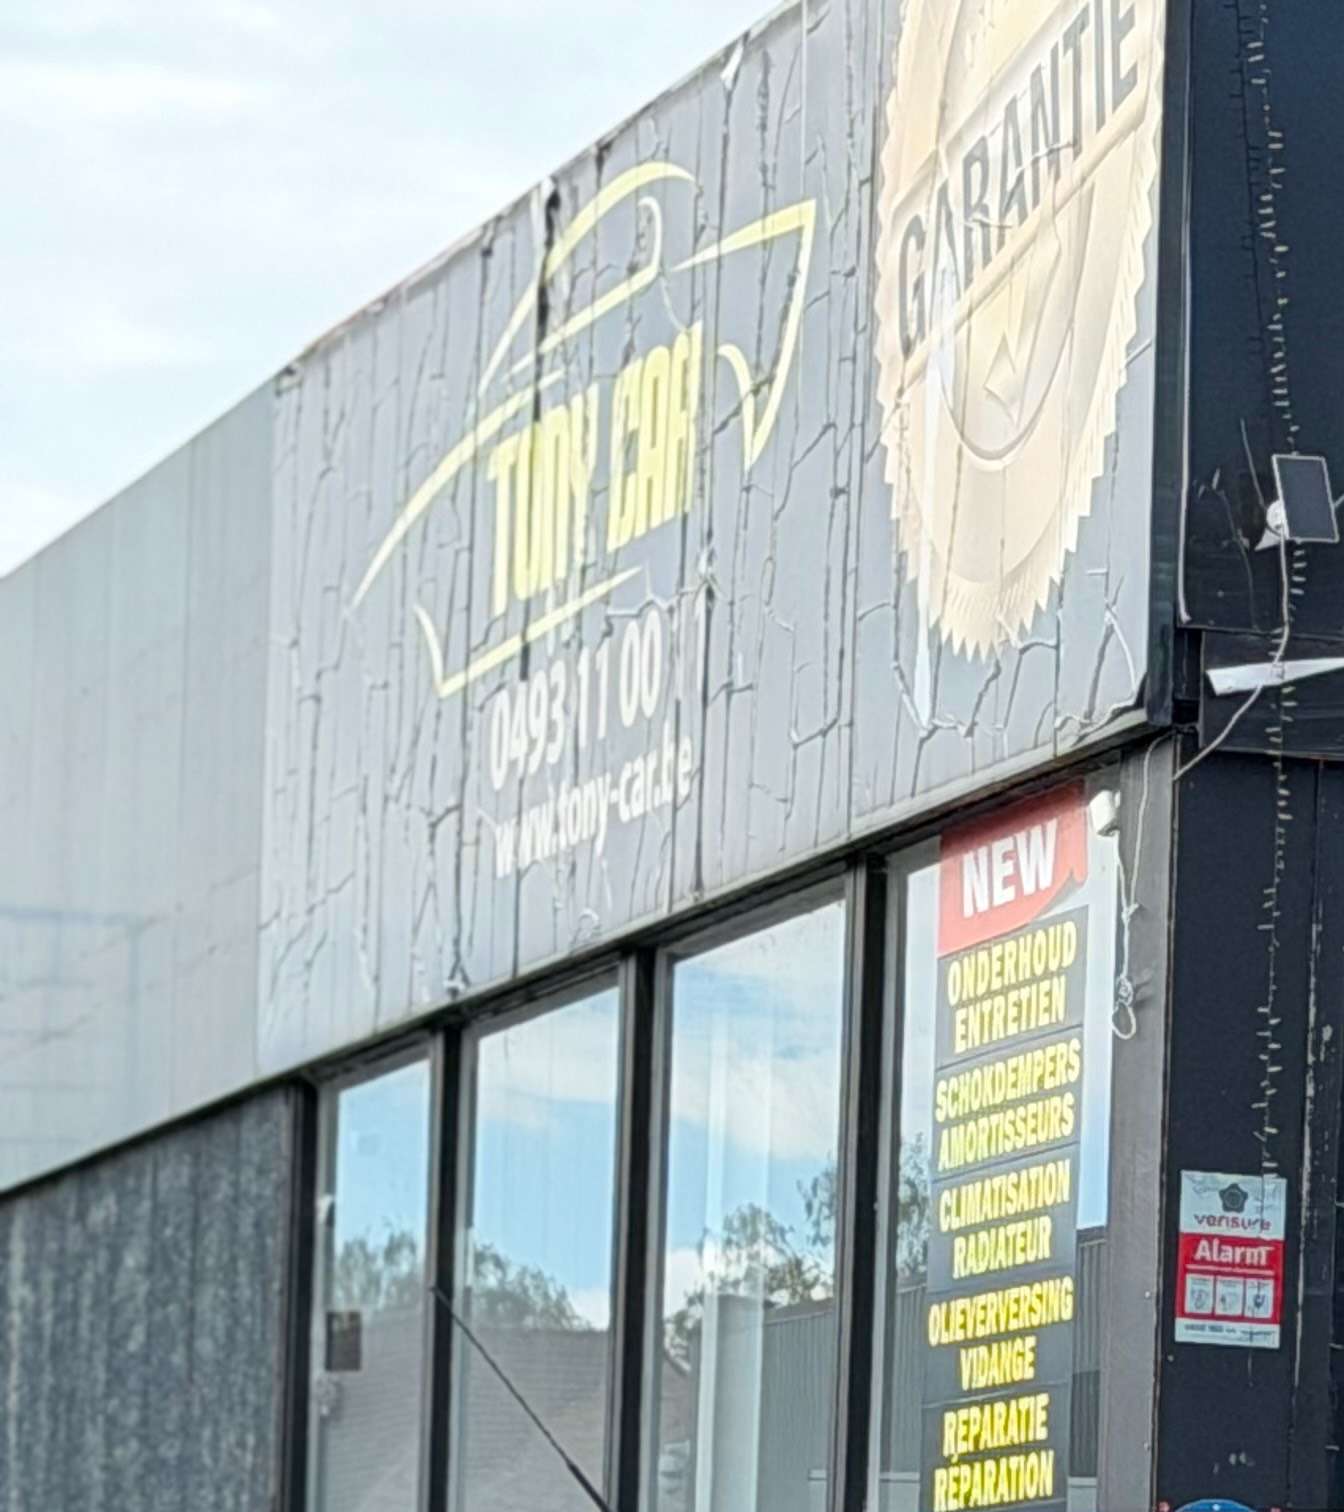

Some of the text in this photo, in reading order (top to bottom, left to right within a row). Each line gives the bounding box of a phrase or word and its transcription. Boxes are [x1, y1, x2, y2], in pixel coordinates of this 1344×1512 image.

[899, 0, 1138, 361] GARANTIE
[487, 320, 704, 618] TONY CAR
[489, 660, 567, 790] 0493
[619, 608, 662, 728] 00
[494, 721, 694, 879] www.tony-car.be
[962, 817, 1059, 918] NEW
[947, 920, 1077, 1007] ONDERHOUD
[954, 974, 1067, 1054] ENTRETIEN
[935, 1038, 1081, 1123] SCHOKDEMPERS
[937, 1091, 1075, 1173] AMORTISSEURS
[938, 1158, 1072, 1233] CLIMATISATION
[952, 1215, 1052, 1280] RADIATEUR
[1194, 1238, 1269, 1267] Alarm
[928, 1275, 1075, 1347] OLIEVERVERSING
[959, 1335, 1038, 1392] VIDANGE
[942, 1393, 1050, 1458] REPARATIE
